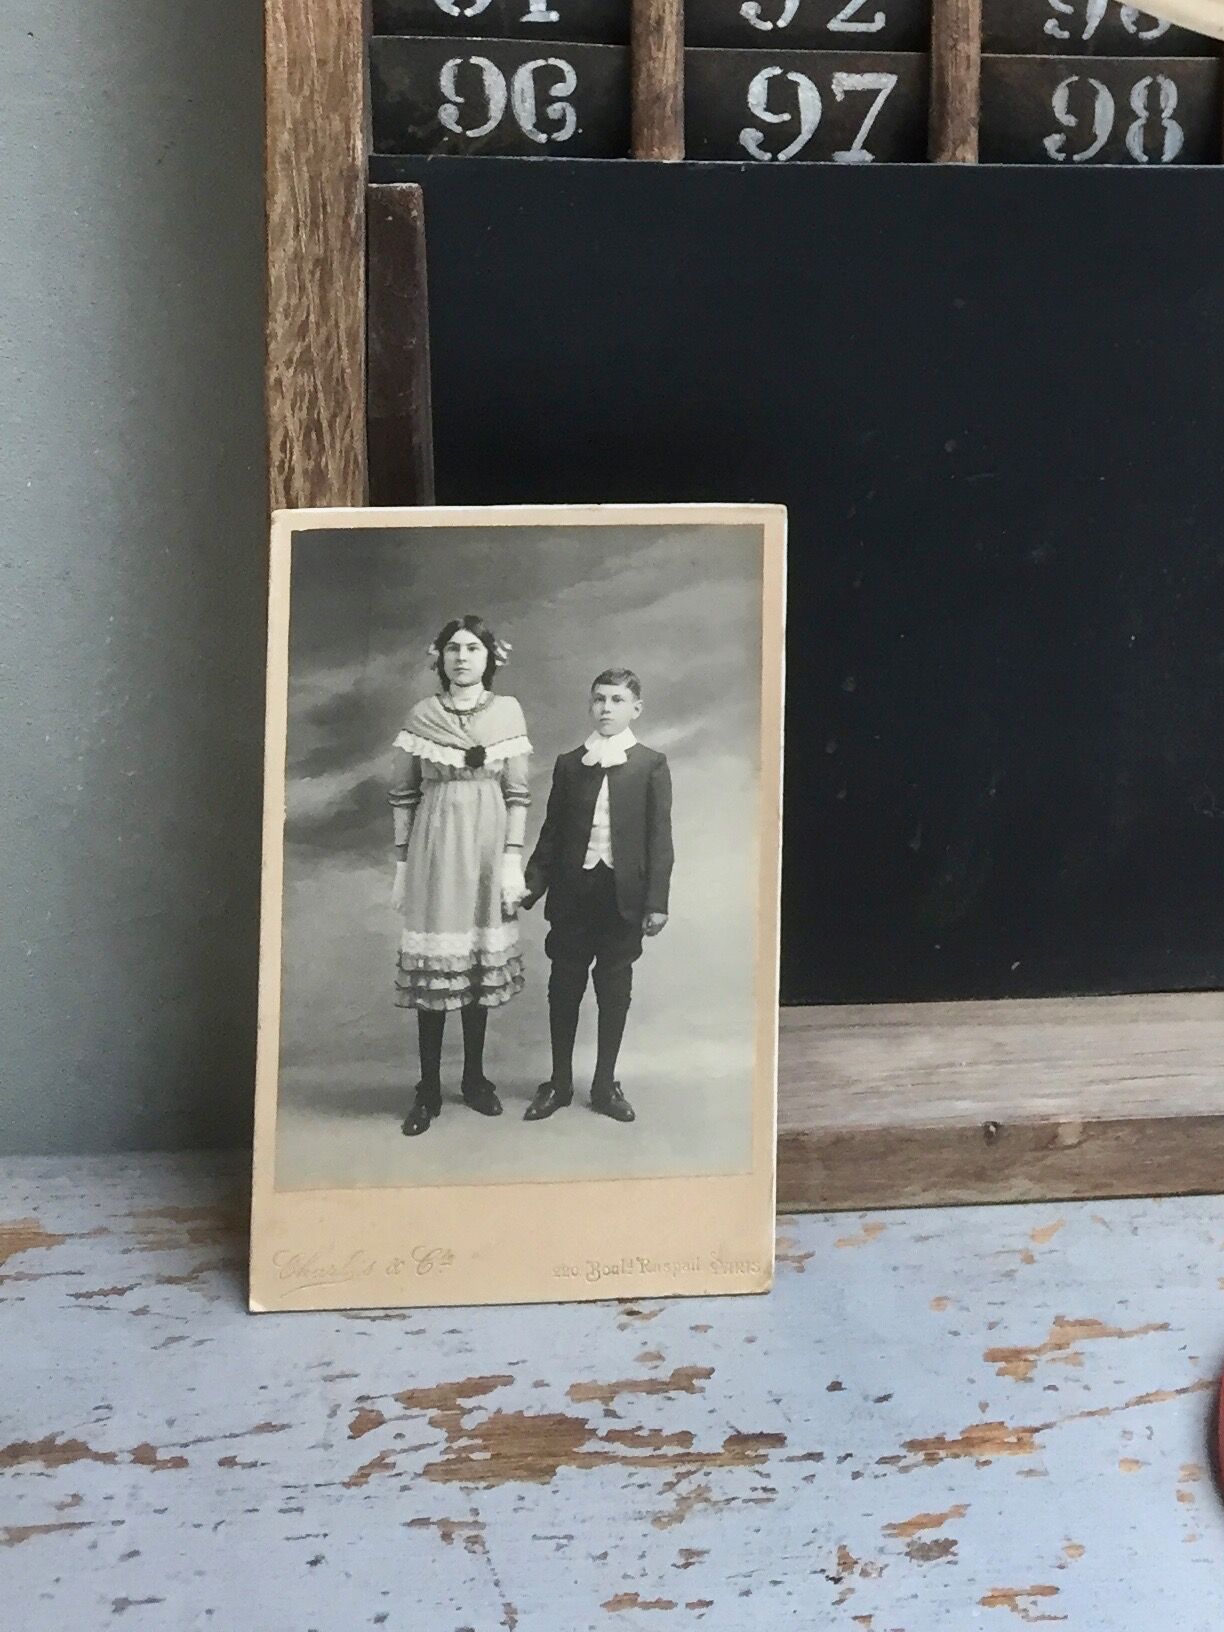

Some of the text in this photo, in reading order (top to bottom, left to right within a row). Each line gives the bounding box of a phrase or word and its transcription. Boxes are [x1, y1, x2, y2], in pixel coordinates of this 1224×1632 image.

[438, 55, 578, 144] 96
[739, 66, 898, 163] 97
[1043, 75, 1184, 163] 98
